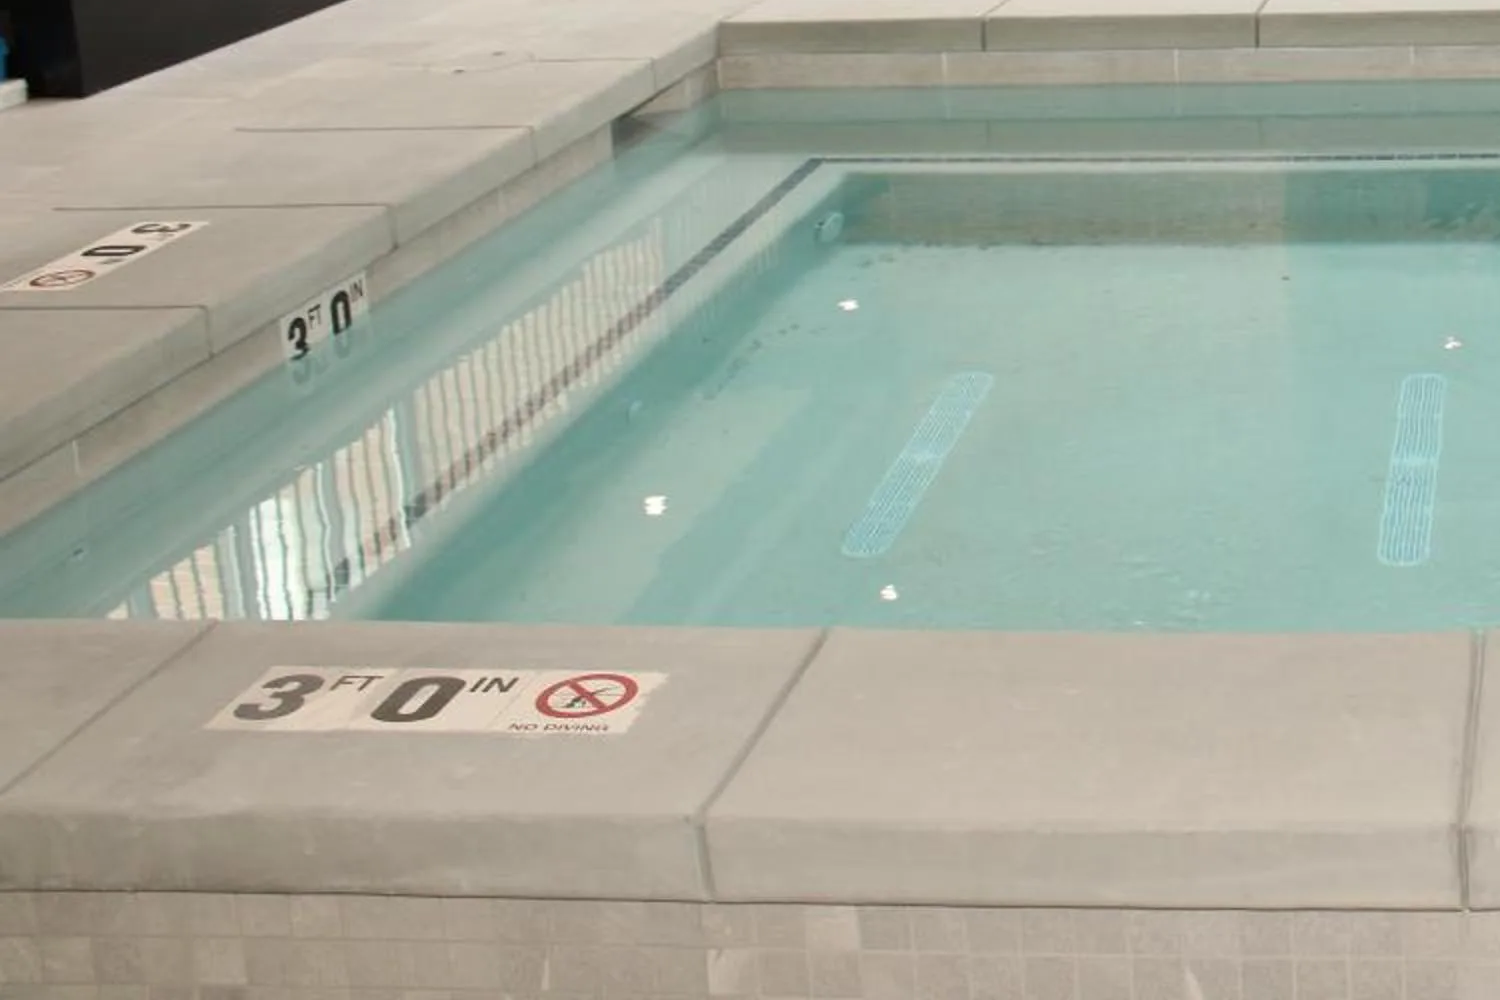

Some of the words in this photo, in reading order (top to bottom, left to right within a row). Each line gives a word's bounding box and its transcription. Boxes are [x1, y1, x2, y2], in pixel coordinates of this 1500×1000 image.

[80, 245, 147, 257] 0
[288, 317, 310, 361] 3
[308, 303, 321, 331] FT
[331, 290, 352, 336] 0
[350, 279, 363, 302] IN
[233, 674, 325, 720] 3
[329, 675, 384, 692] FT
[370, 676, 466, 723] 0
[467, 676, 519, 694] IN
[509, 723, 538, 731] NO
[543, 723, 609, 731] DIVING
